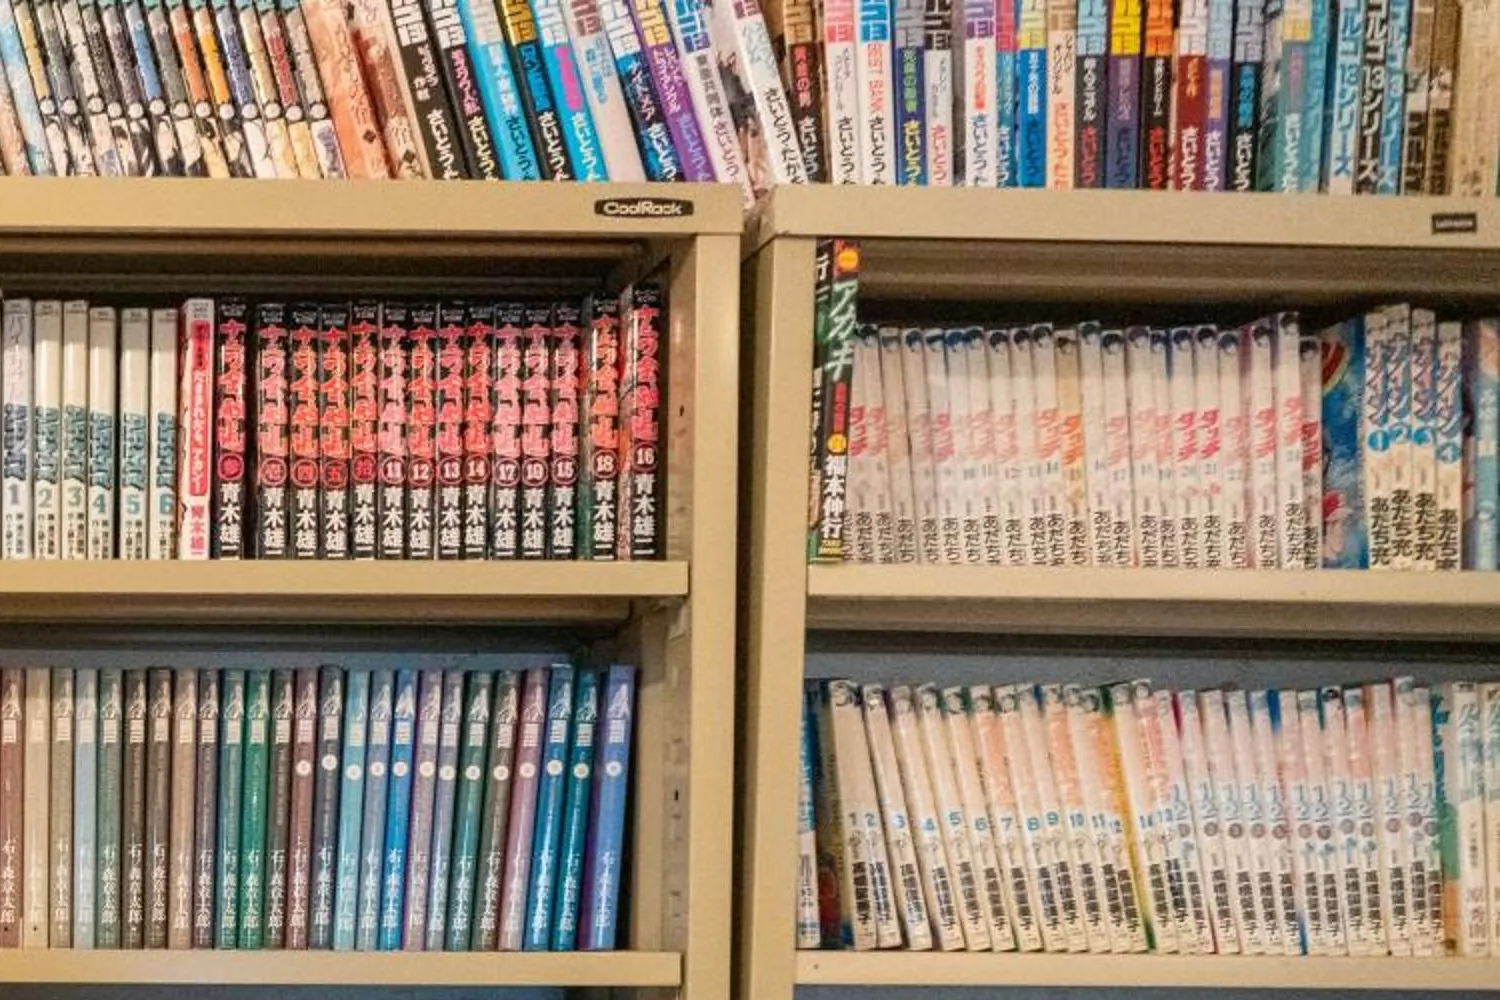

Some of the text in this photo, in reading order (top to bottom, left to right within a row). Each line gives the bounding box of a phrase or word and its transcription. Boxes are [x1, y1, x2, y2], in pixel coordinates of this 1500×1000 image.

[827, 279, 858, 382] アカギ
[412, 464, 429, 480] 12
[443, 461, 461, 478] 13
[498, 463, 516, 480] 17
[596, 455, 614, 472] 18
[410, 487, 431, 556] 青木雄二
[441, 487, 461, 555] 青木雄二
[466, 460, 487, 554] 14 青木雄二
[553, 486, 574, 554] 青木雄二
[634, 473, 655, 555] 青木雄二
